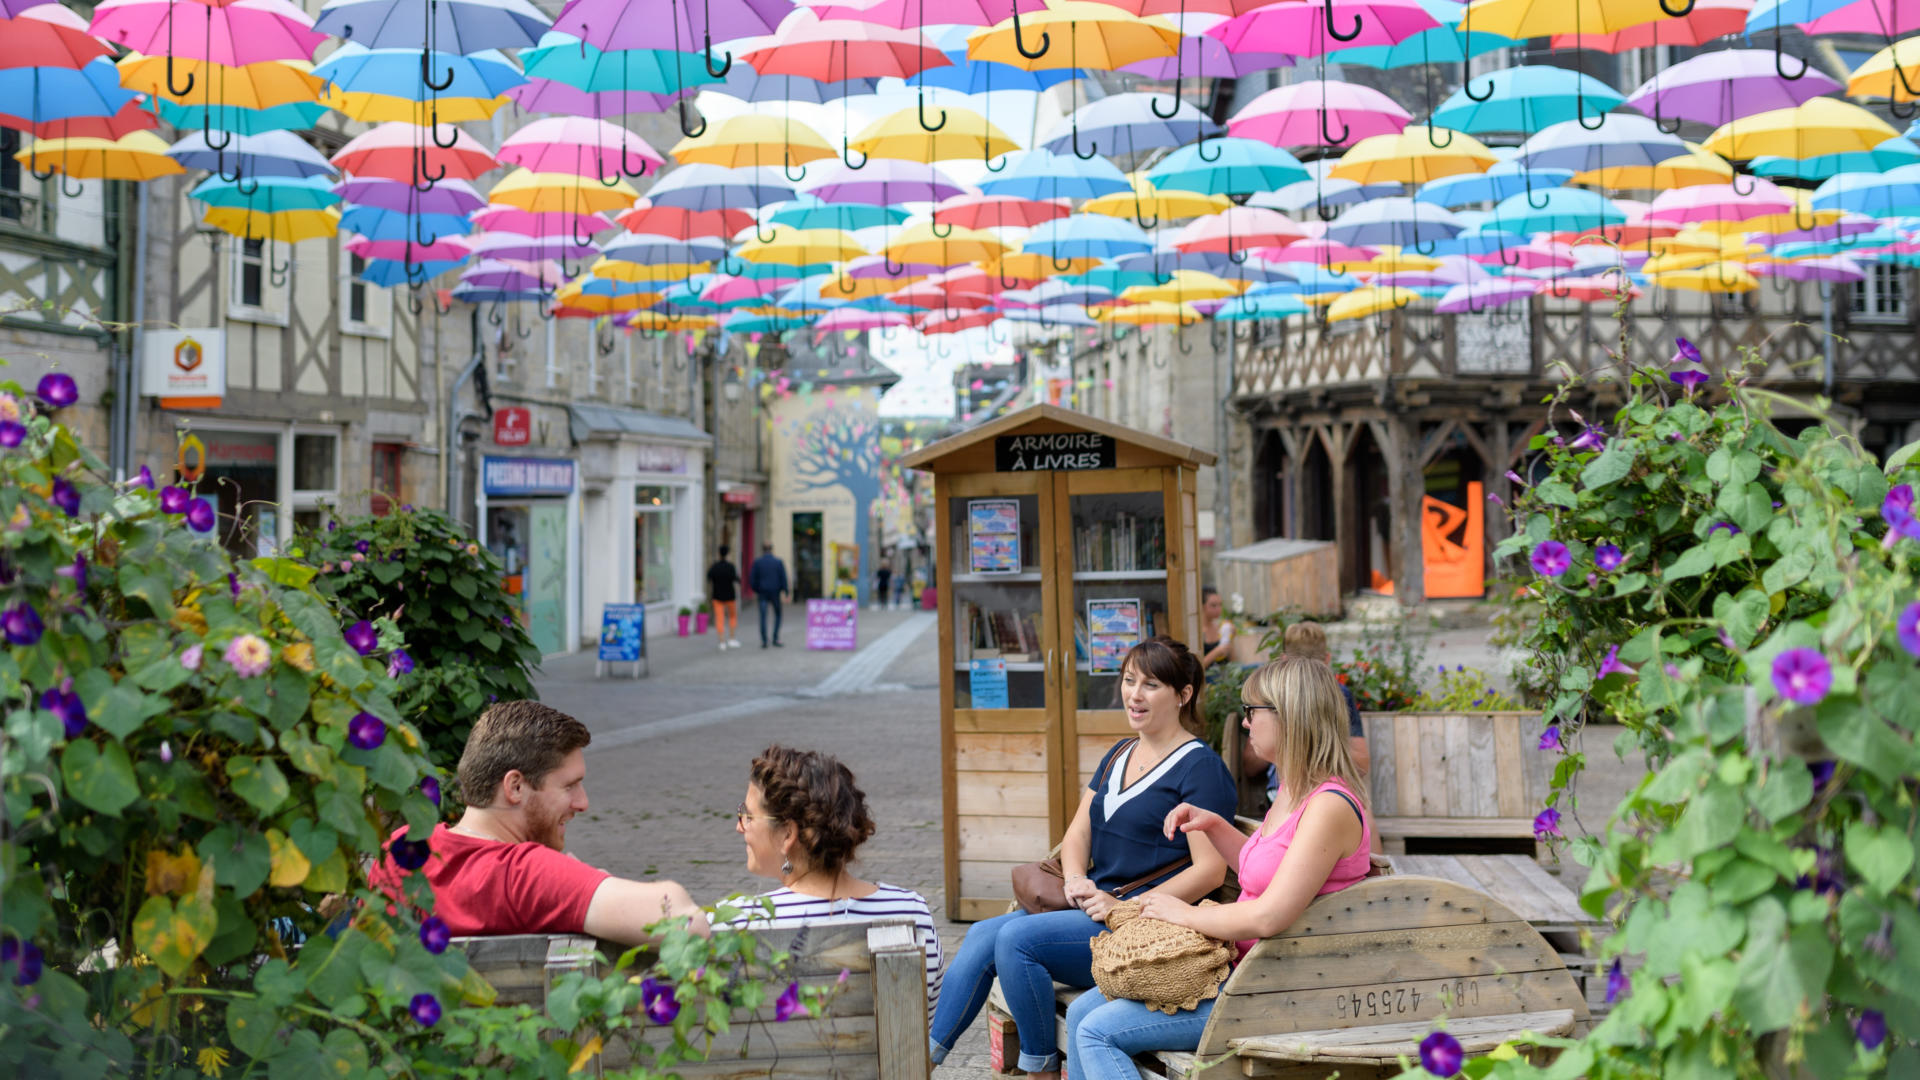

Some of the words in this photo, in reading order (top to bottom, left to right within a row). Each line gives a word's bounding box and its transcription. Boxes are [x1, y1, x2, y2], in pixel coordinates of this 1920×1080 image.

[208, 440, 275, 461] Harmonie
[1009, 434, 1103, 452] ARMOIRE
[1012, 451, 1027, 471] À
[1033, 453, 1102, 470] LIVRES
[1336, 987, 1421, 1019] 425545
